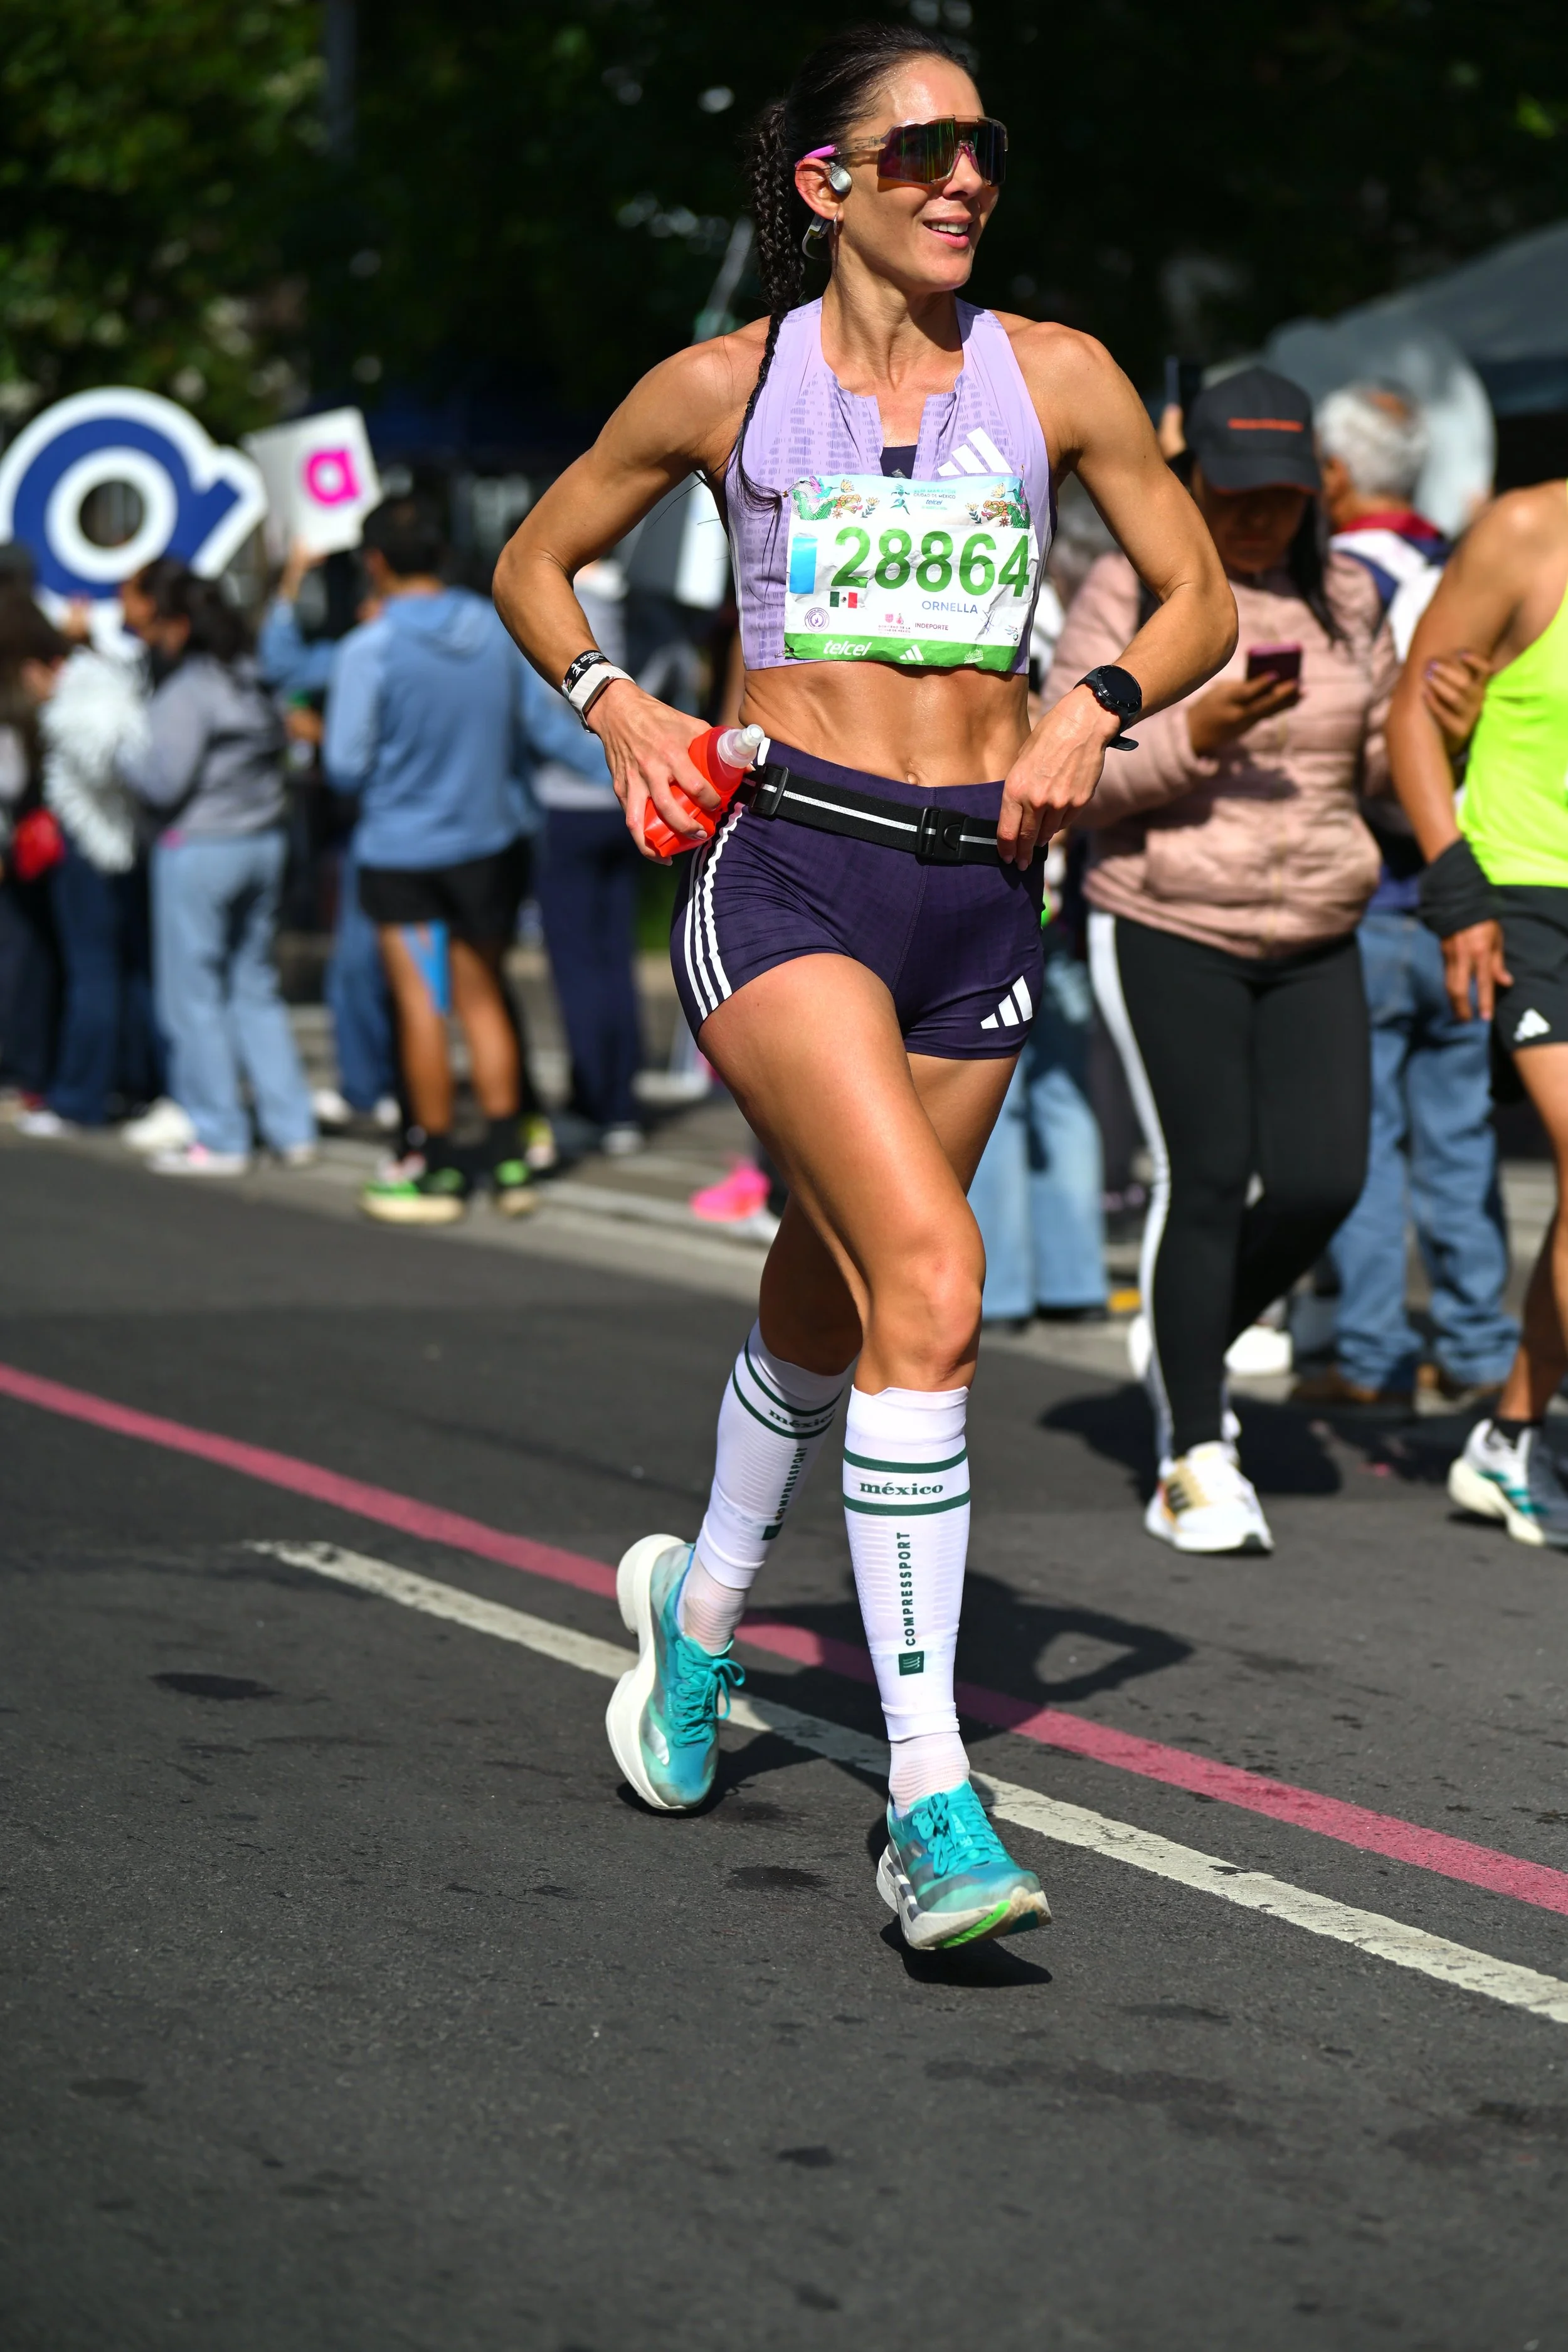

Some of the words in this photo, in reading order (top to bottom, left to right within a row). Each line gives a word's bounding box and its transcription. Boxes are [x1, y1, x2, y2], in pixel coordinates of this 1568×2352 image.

[830, 526, 1030, 597] 28864
[922, 601, 978, 613] ORNELLA
[823, 640, 872, 656] telcel
[775, 1447, 808, 1521] COMPRESSPORT
[860, 1482, 943, 1495] méxico
[896, 1532, 916, 1646] COMPRESSPORT
